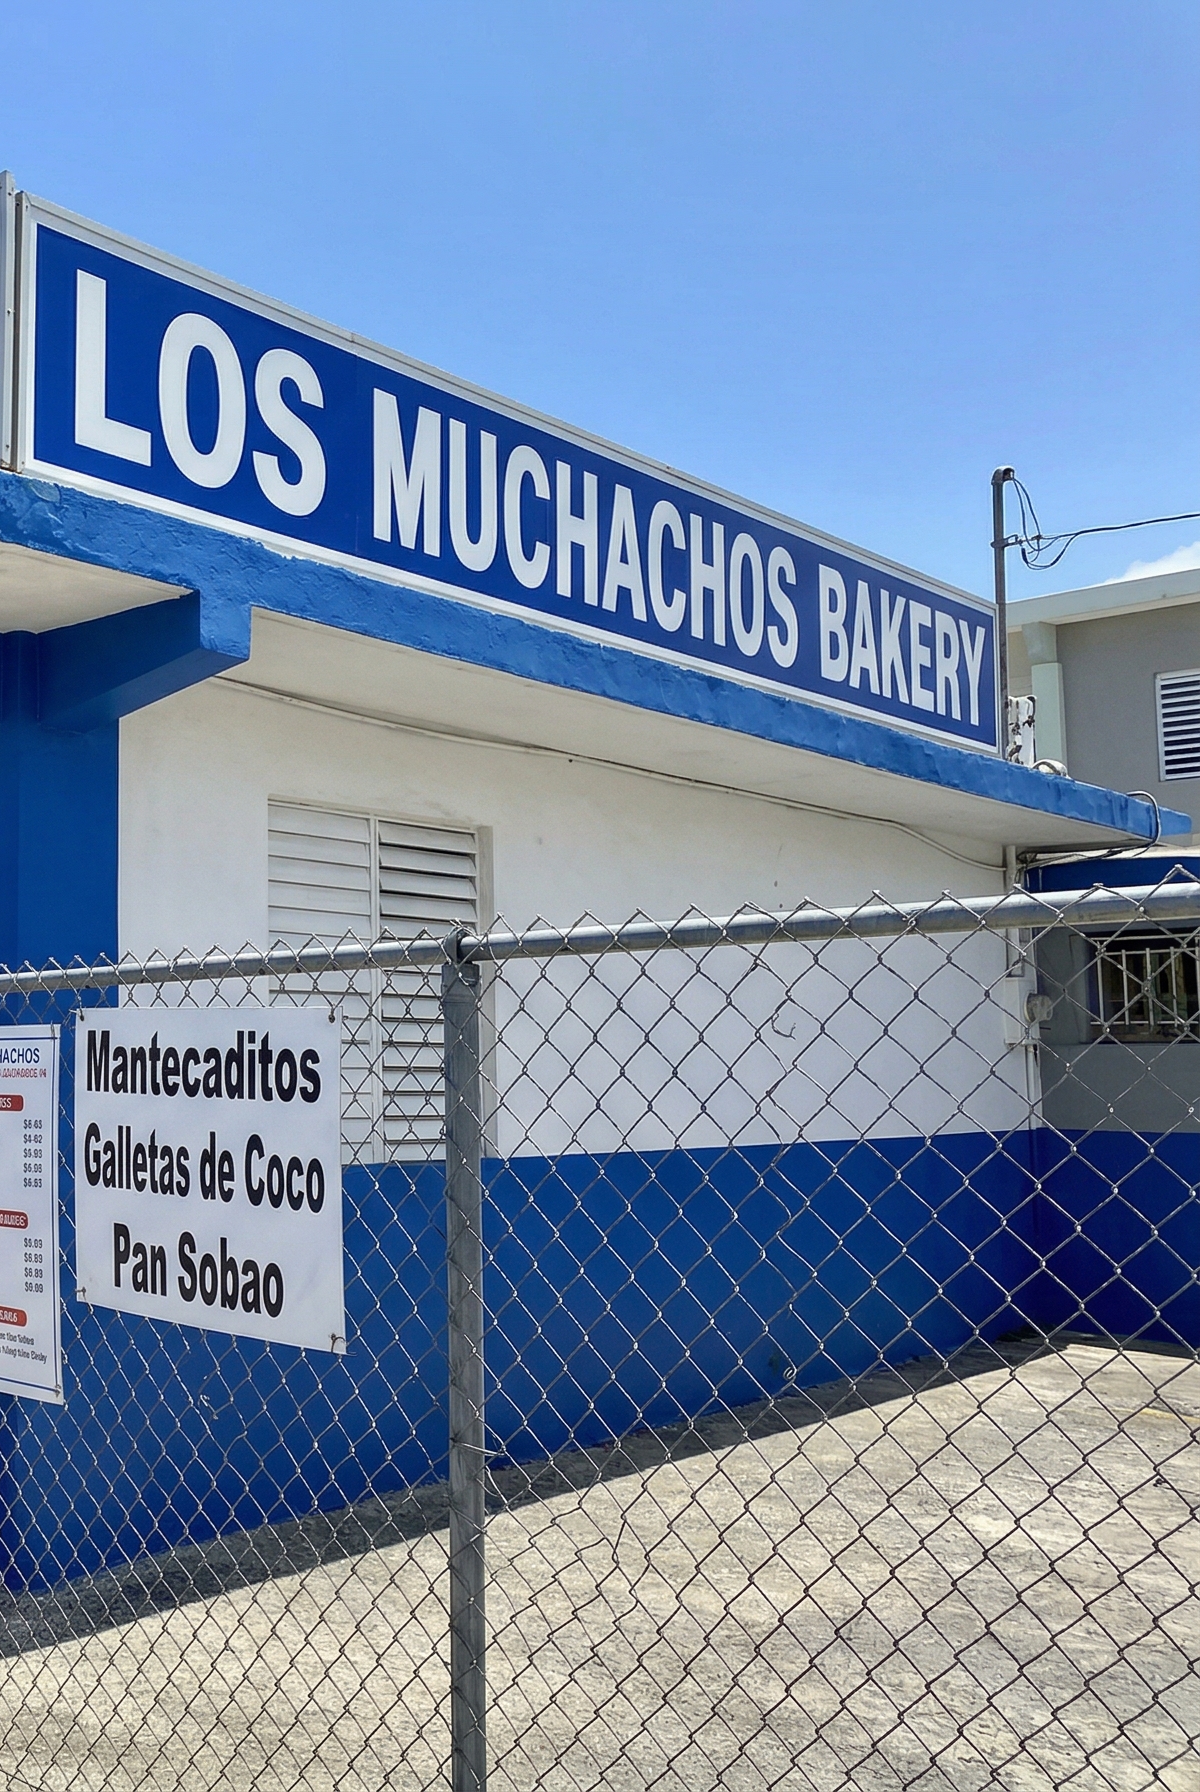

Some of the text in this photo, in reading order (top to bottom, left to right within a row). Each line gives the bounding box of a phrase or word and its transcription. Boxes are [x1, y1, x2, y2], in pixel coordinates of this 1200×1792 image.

[74, 270, 986, 726] LOS MUCHACHOS BAKERY
[86, 1030, 321, 1103] Mantecaditos
[84, 1122, 325, 1214] Galletas de Coco
[113, 1222, 284, 1318] Pan Sobao
